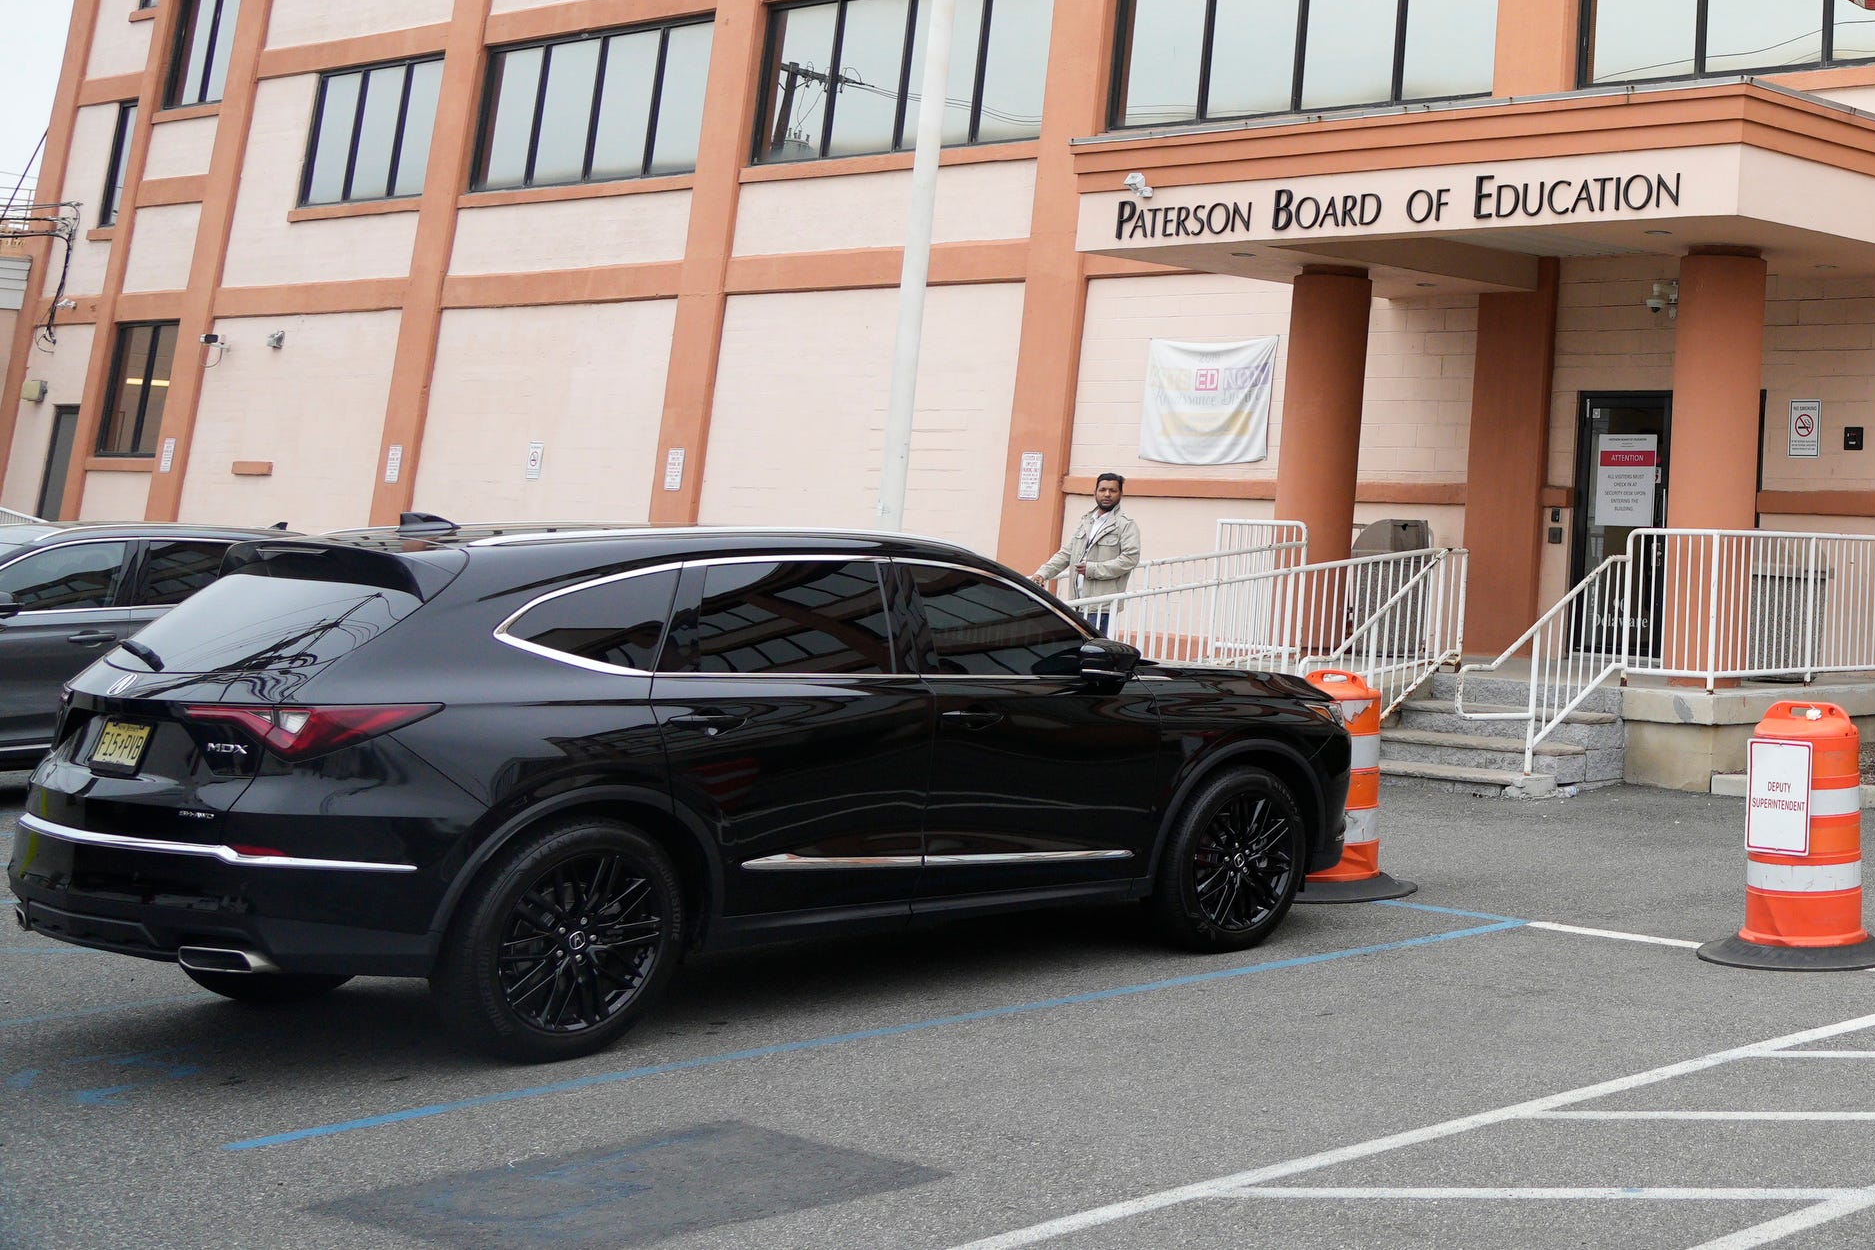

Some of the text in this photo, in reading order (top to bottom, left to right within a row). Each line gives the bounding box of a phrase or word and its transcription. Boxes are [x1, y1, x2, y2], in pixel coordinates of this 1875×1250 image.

[1115, 172, 1682, 241] PATERSON BOARD OF EDUCATION
[1196, 369, 1219, 390] ED
[1611, 454, 1644, 462] ATTENTION
[207, 742, 249, 755] MDX
[1767, 781, 1792, 793] DEPUTY
[1751, 797, 1806, 812] SUPERINTENDENT
